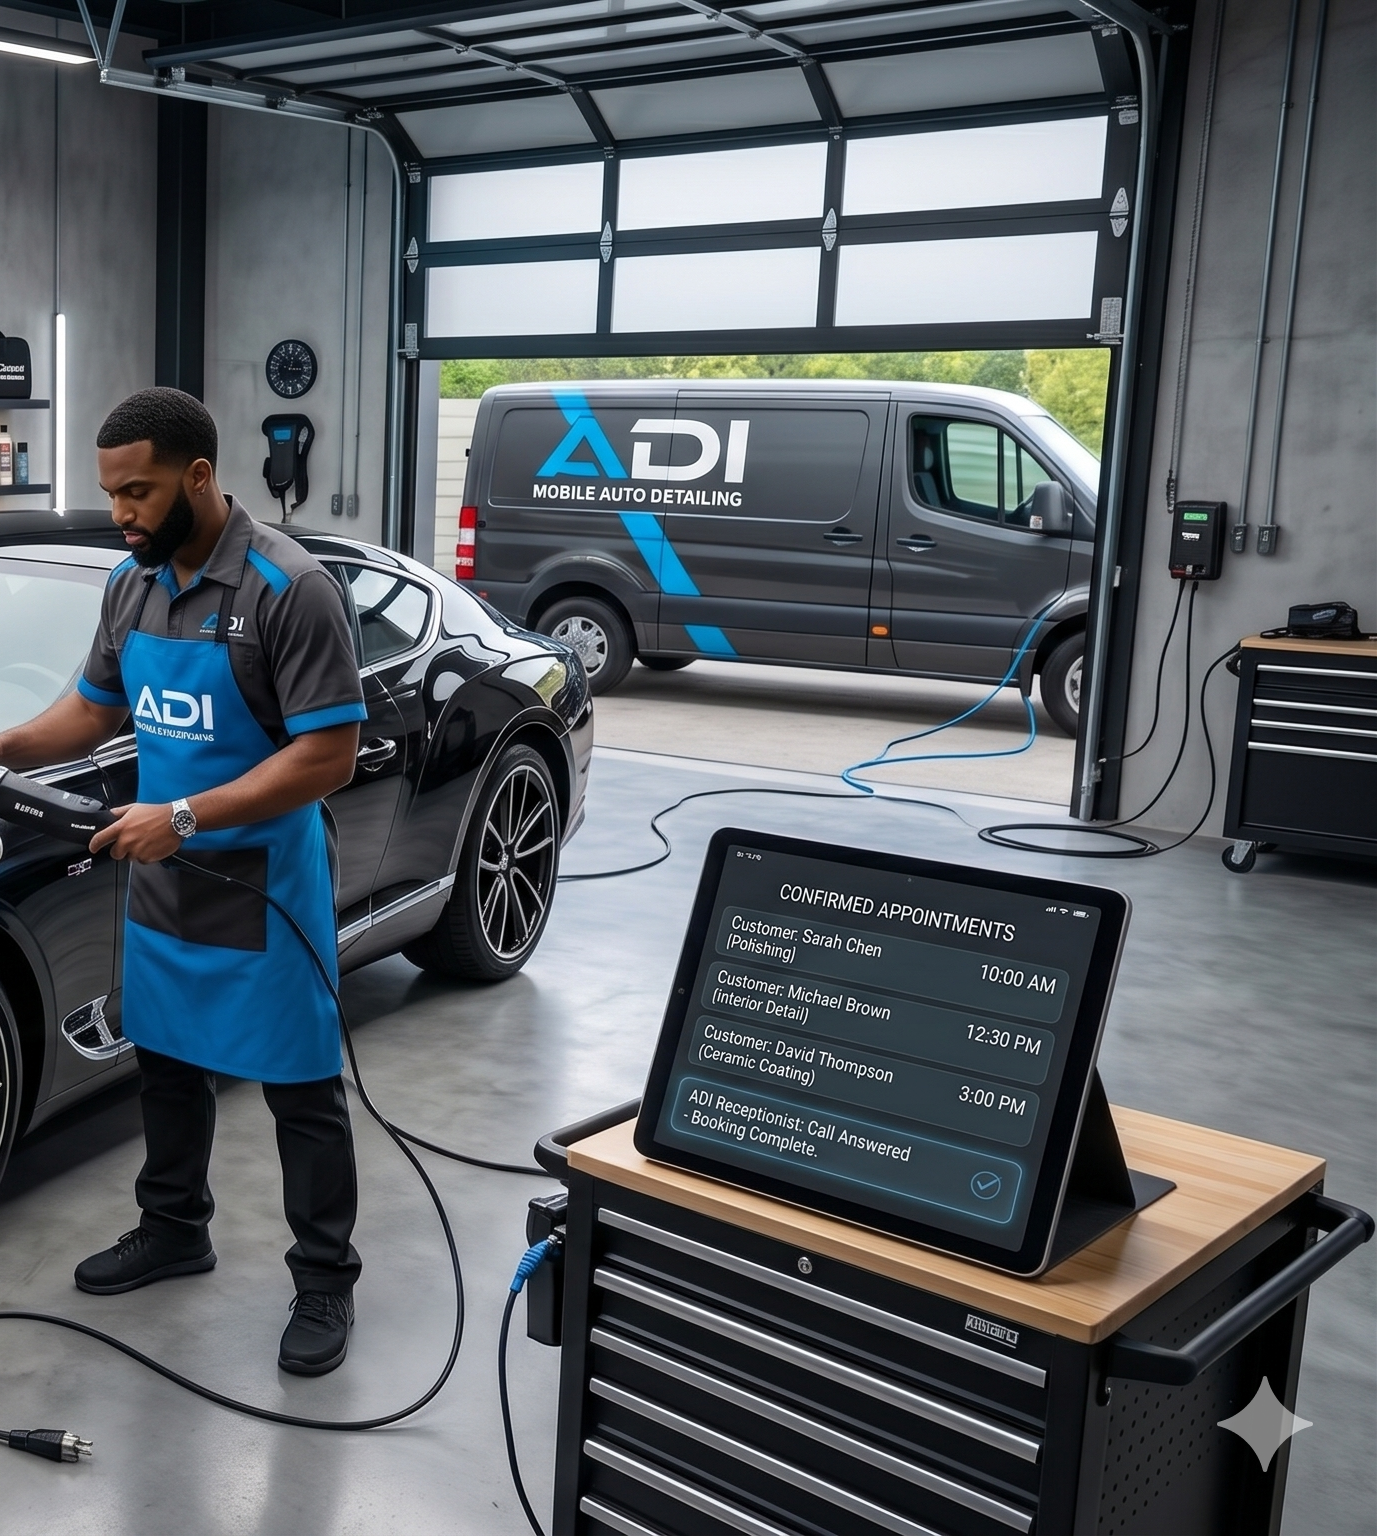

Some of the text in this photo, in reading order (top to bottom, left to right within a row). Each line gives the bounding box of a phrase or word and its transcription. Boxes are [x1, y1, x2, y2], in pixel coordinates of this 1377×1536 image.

[535, 416, 750, 483] ADI
[532, 484, 742, 507] MOBILE AUTO DETAILING
[135, 685, 214, 730] ADI
[780, 883, 1016, 942] CONFIRMED APPOINTMENTS
[802, 928, 842, 950] Sarah
[846, 937, 882, 958] Chen
[717, 969, 891, 1020] Customer: Michael Brown
[981, 964, 1057, 995] 10:00 AM
[765, 1000, 809, 1025] Detail)
[704, 1024, 894, 1083] Customer: David Thompson
[967, 1024, 1042, 1055] 12:30 PM
[698, 1043, 815, 1087] (Ceramic Coating)
[958, 1085, 1026, 1116] 3:00 PM
[688, 1089, 911, 1162] ADI Receptionist: Call Answered
[691, 1109, 747, 1141] Booking
[749, 1126, 818, 1158] Complete.
